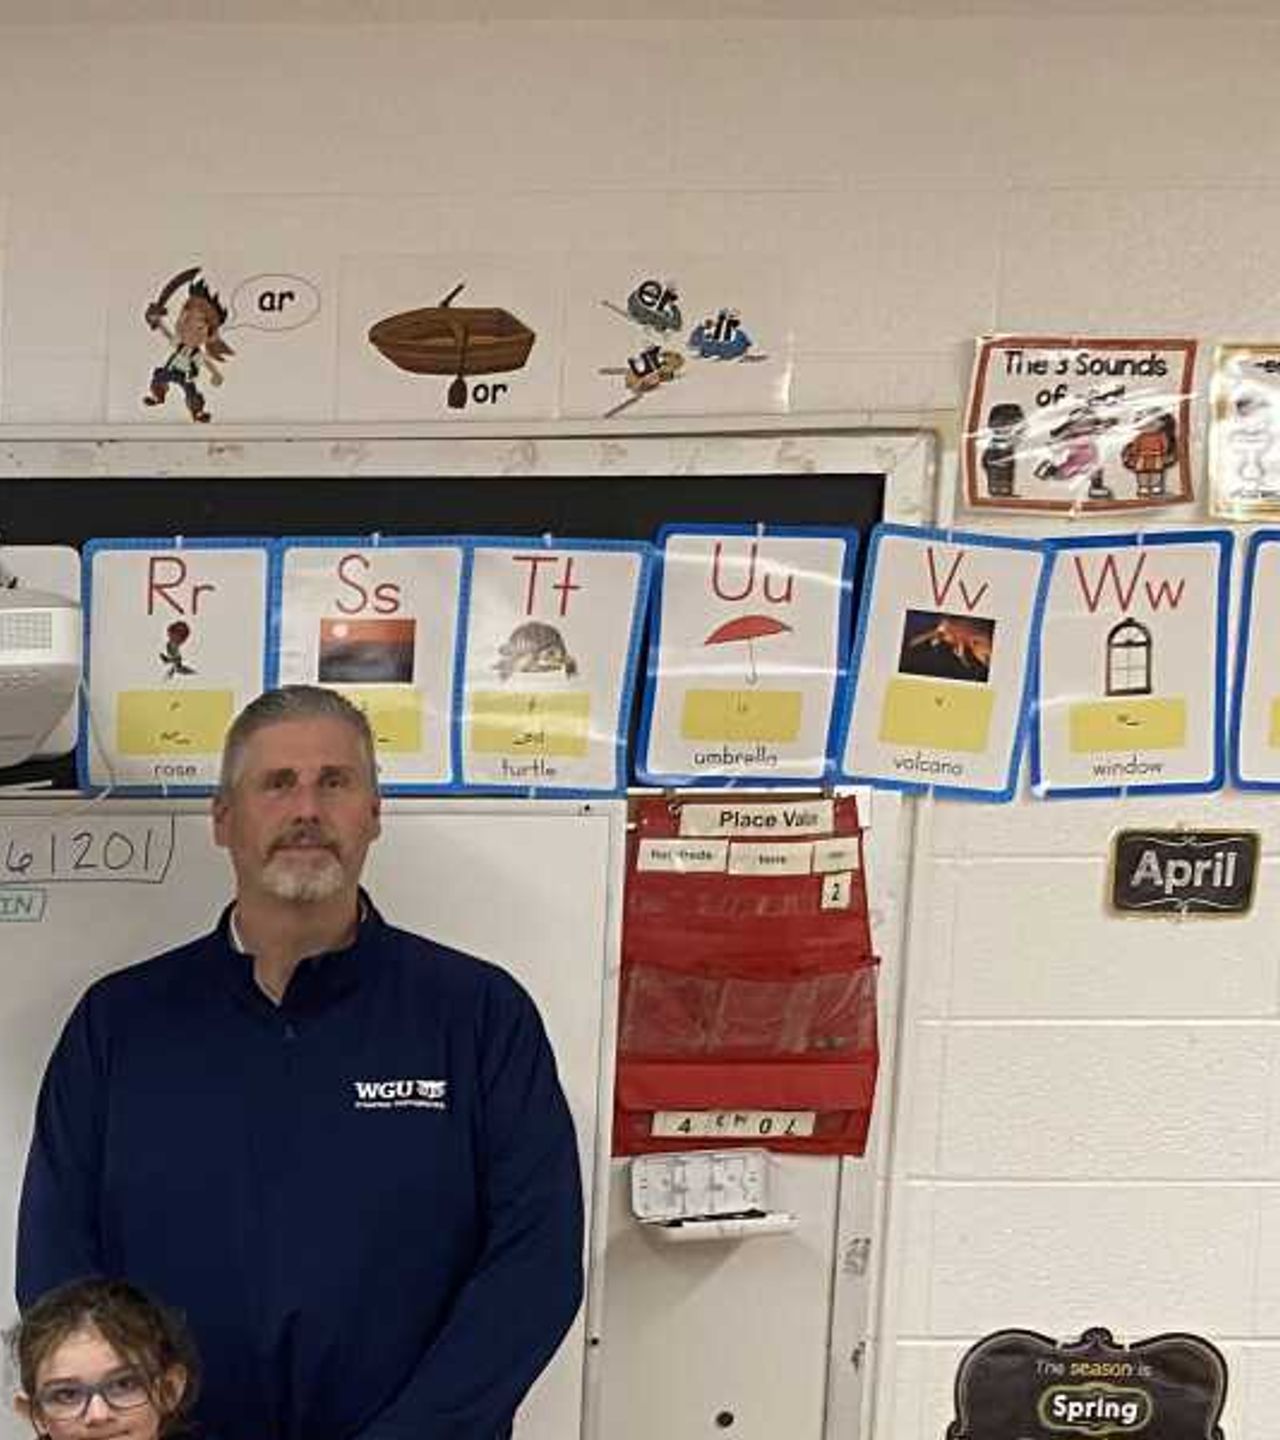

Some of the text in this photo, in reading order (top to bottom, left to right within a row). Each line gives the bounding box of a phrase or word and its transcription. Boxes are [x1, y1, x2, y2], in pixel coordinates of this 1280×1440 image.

[257, 286, 295, 313] ar
[638, 280, 678, 307] er
[627, 342, 664, 377] ur
[1004, 350, 1169, 377] The Sounds
[472, 379, 508, 403] or
[1035, 384, 1068, 407] of
[146, 556, 216, 616] Rr
[336, 554, 402, 615] Ss
[512, 555, 582, 617] Tt
[710, 542, 794, 604] Uu
[926, 545, 989, 611] Vv
[1074, 552, 1187, 613] Ww
[153, 762, 198, 777] rose
[500, 759, 558, 778] turtle
[693, 746, 777, 767] umbrella
[892, 755, 964, 777] volcano
[1092, 756, 1164, 778] window
[719, 810, 778, 827] Place
[1130, 850, 1239, 895] April
[353, 1079, 414, 1099] WGU
[1036, 1360, 1132, 1377] The season
[1051, 1394, 1139, 1424] Spring
